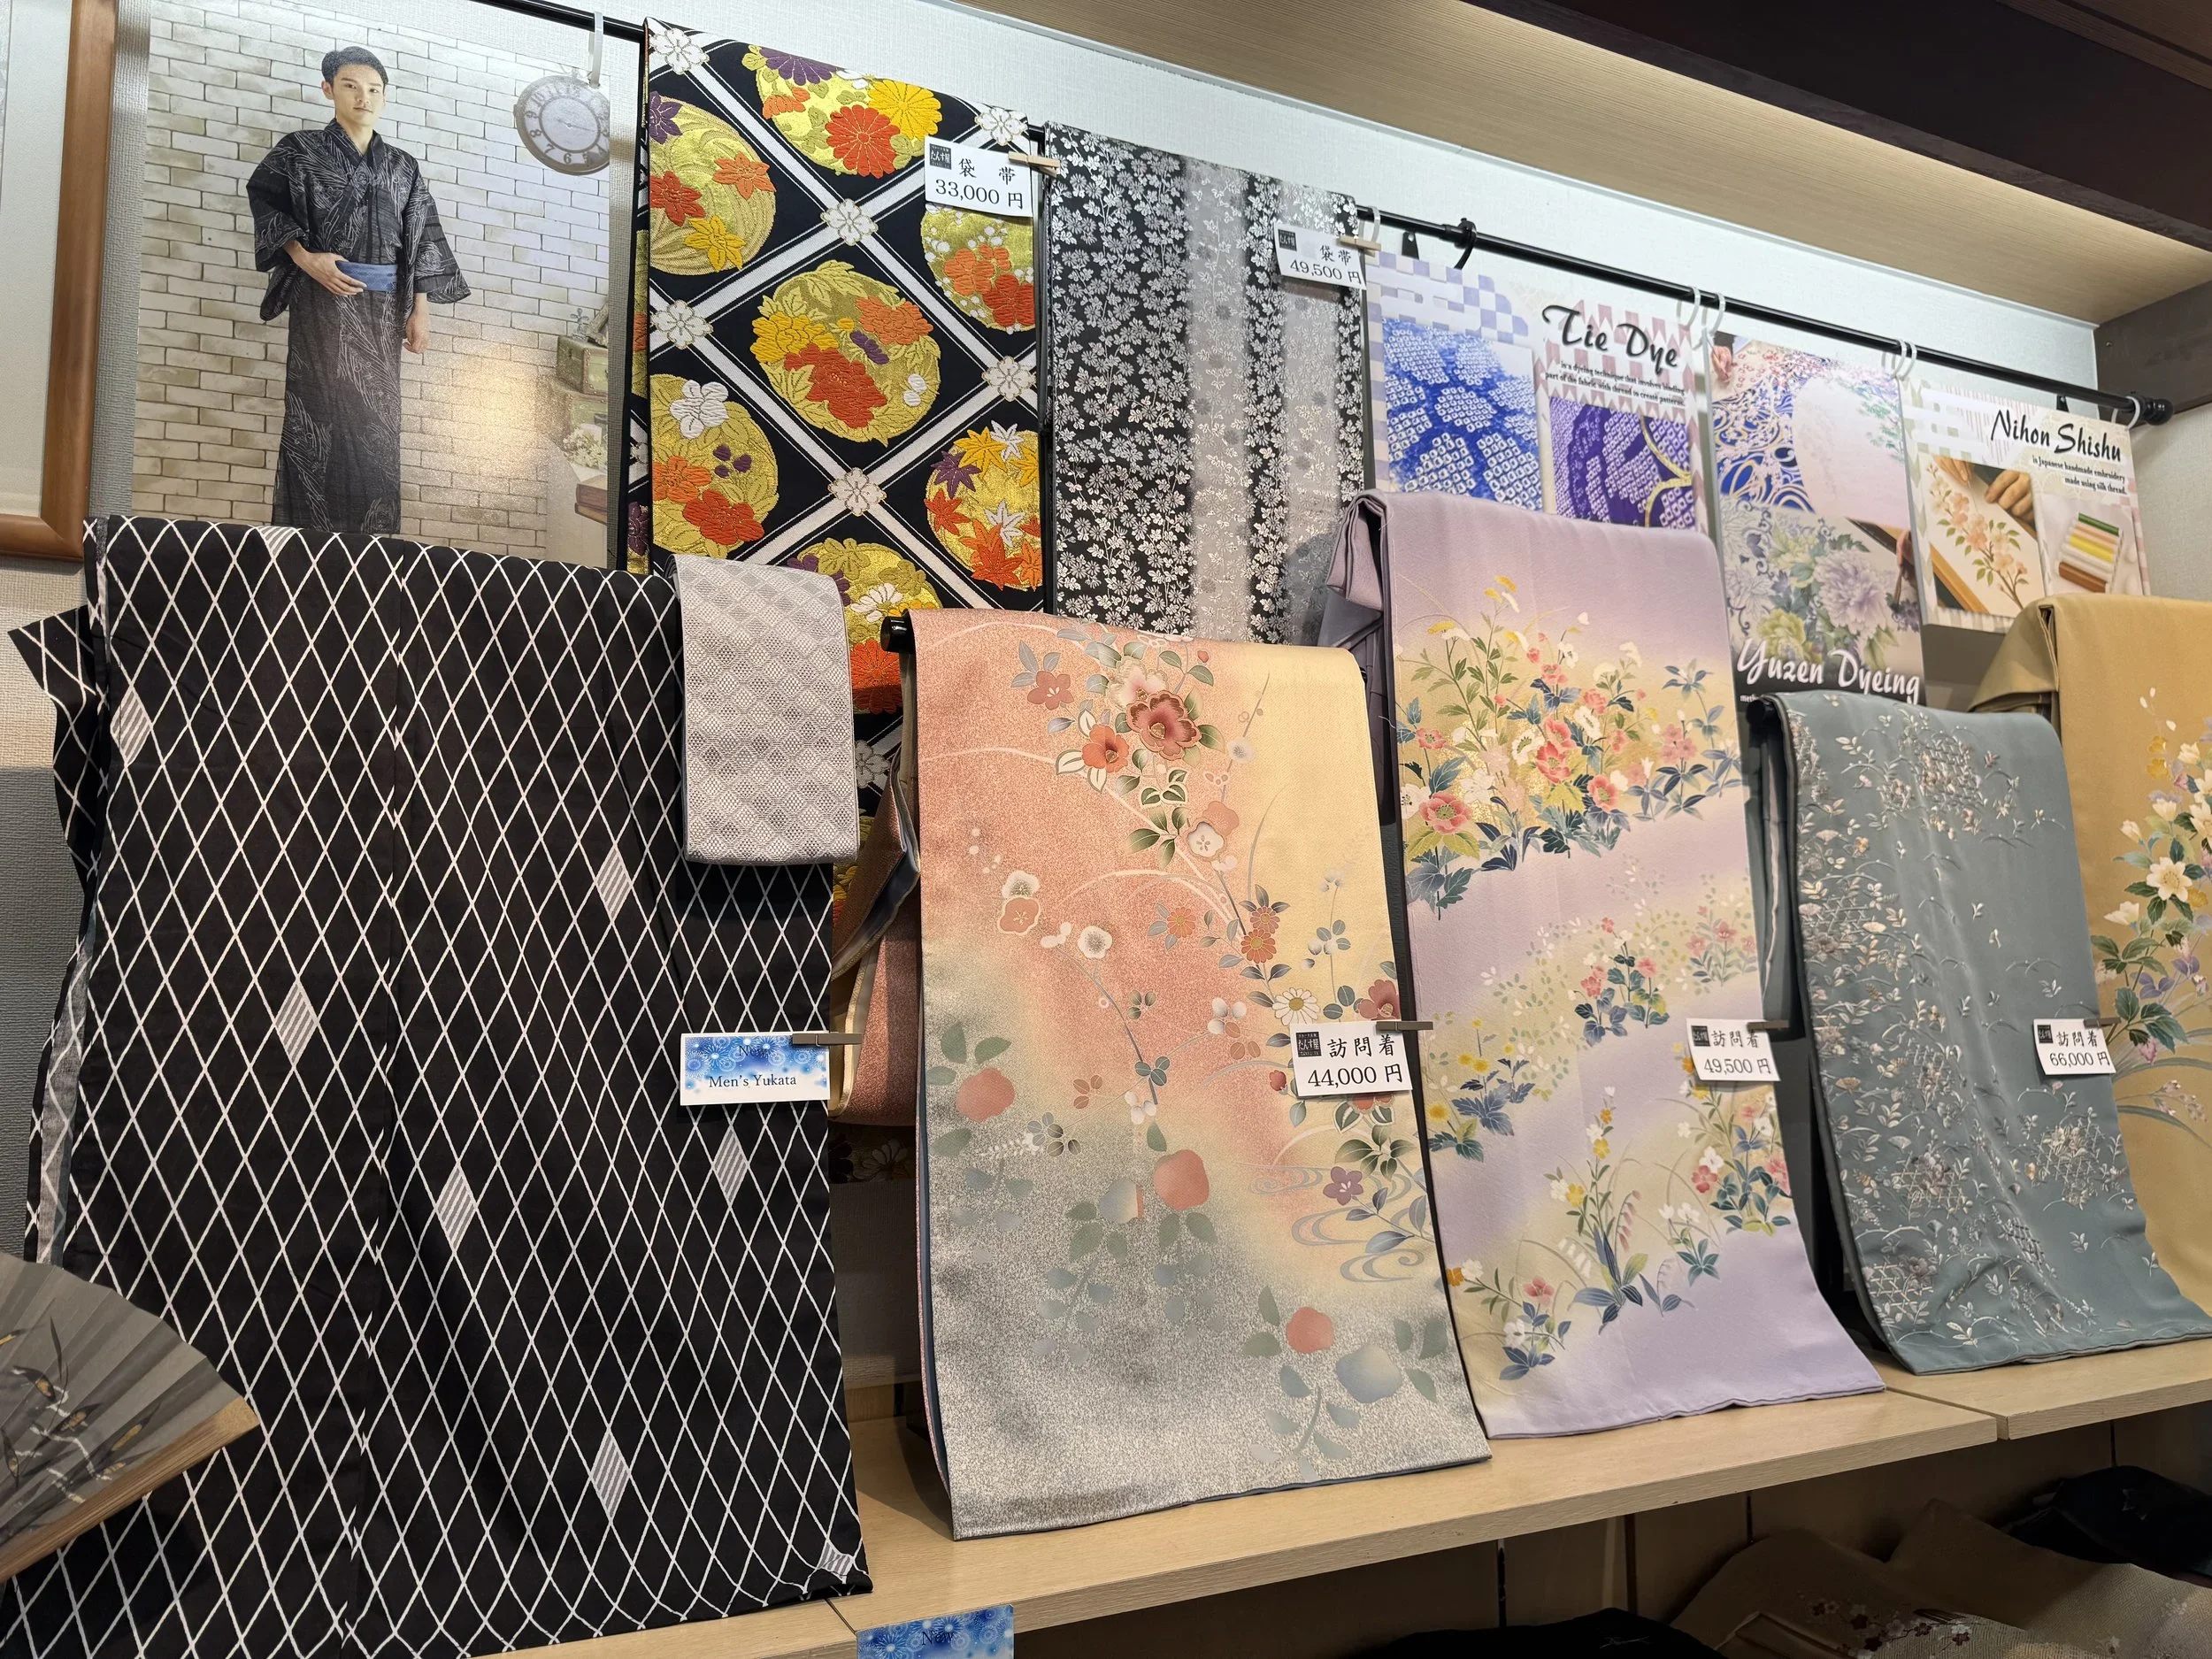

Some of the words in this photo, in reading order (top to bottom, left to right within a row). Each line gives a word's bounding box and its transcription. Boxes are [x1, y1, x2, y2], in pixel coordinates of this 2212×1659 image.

[935, 179, 1000, 204] 33,000
[1290, 259, 1342, 280] 49,500
[1542, 305, 1609, 351] Tie
[1617, 323, 1678, 375] Dye
[1545, 372, 1558, 380] part
[1578, 377, 1596, 388] fabric
[1612, 385, 1632, 396] thread
[1573, 364, 1594, 377] dyeing
[1594, 369, 1624, 381] technique
[1624, 375, 1637, 384] that
[1991, 410, 2050, 447] Nihon
[2054, 423, 2121, 462] Shishu
[2039, 456, 2063, 468] Japanese
[2064, 462, 2093, 475] handmade
[2094, 469, 2125, 483] embroidery
[2065, 476, 2079, 485] made
[2081, 479, 2096, 490] using
[1737, 638, 1824, 685] Yuzen
[1827, 649, 1921, 704] Dyeing
[1327, 1034, 1395, 1058] 訪問着
[1711, 1030, 1759, 1048] 訪問着
[2056, 1030, 2098, 1048] 訪問着
[1703, 1058, 1753, 1075] 49,500
[2049, 1052, 2093, 1067] 66,000
[752, 1073, 796, 1087] Yukata
[1308, 1066, 1377, 1088] 44,000
[922, 1631, 955, 1646] New
